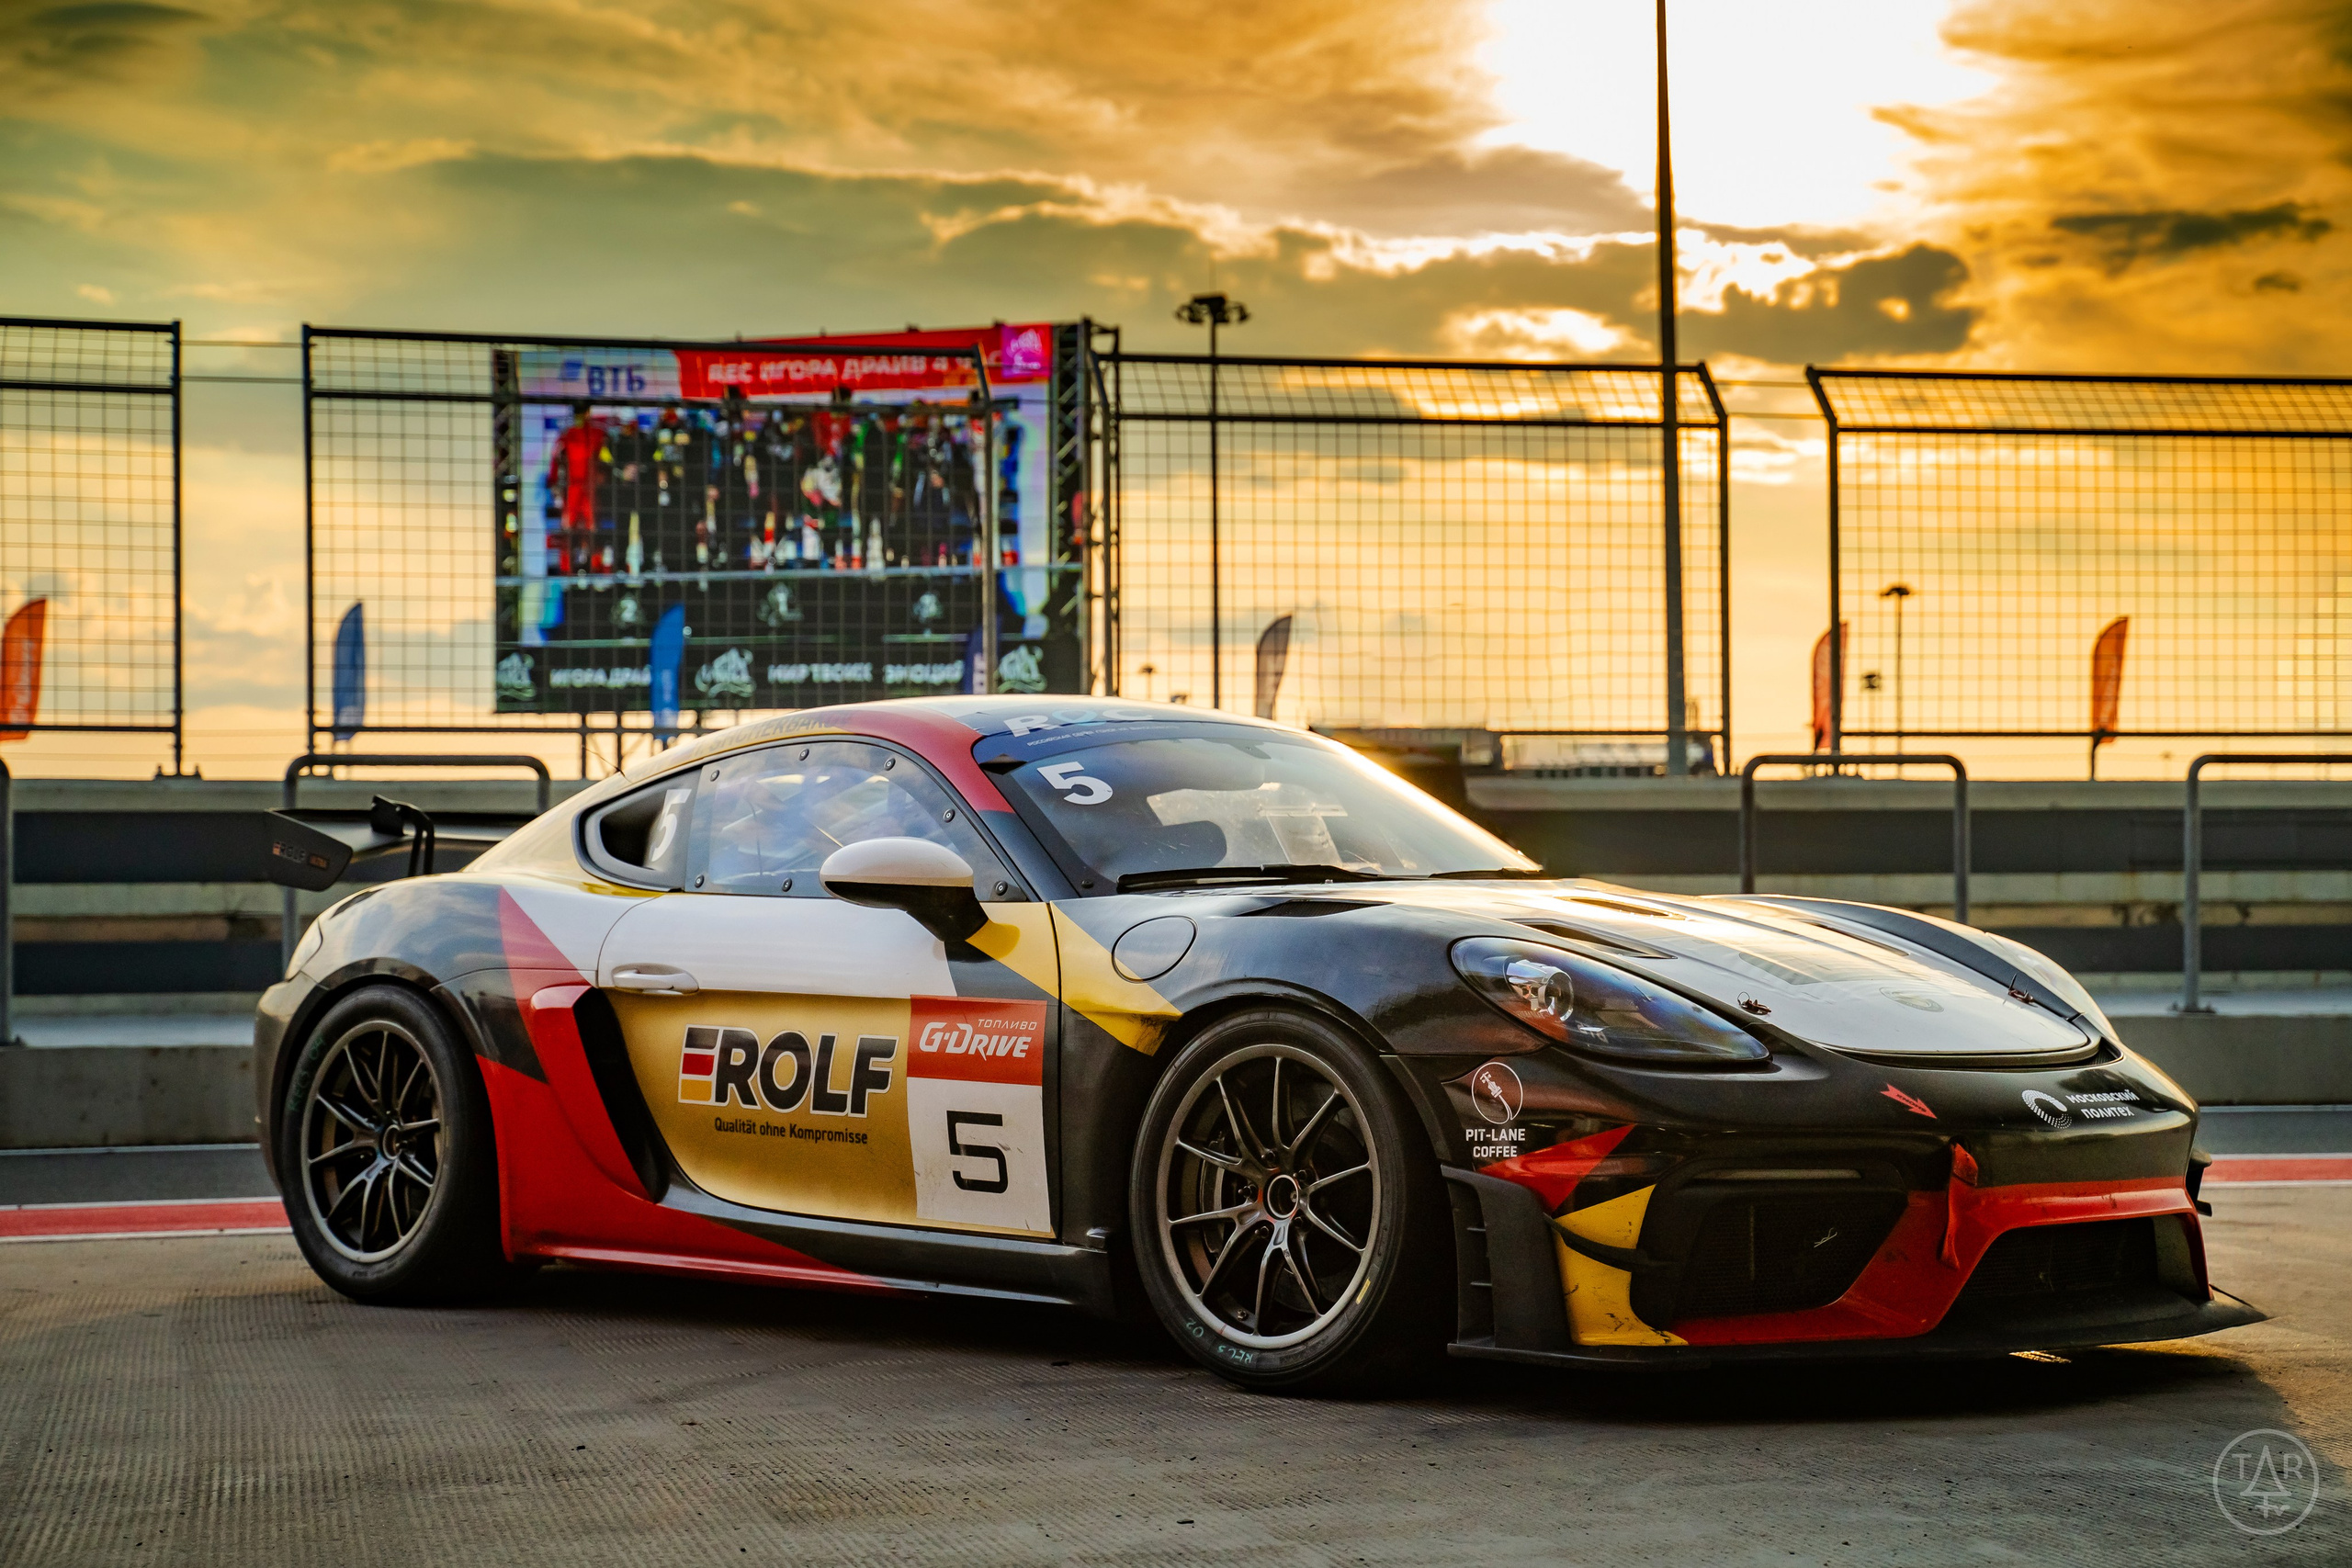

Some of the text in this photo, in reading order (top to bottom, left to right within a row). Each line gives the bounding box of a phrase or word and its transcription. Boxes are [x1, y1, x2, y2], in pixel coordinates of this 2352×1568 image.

[588, 364, 645, 396] ВТБ
[1036, 761, 1114, 806] 5
[650, 788, 692, 862] 5
[978, 1018, 1037, 1031] ТОПЛИВО
[711, 1026, 900, 1119] ROLF
[2065, 1089, 2140, 1103] МОСКОВСКИЙ
[715, 1117, 868, 1145] Qualität ohne Kompromisse
[1465, 1128, 1526, 1141] PIT-LANE
[946, 1110, 1009, 1194] 5
[1473, 1145, 1518, 1157] COFFEE
